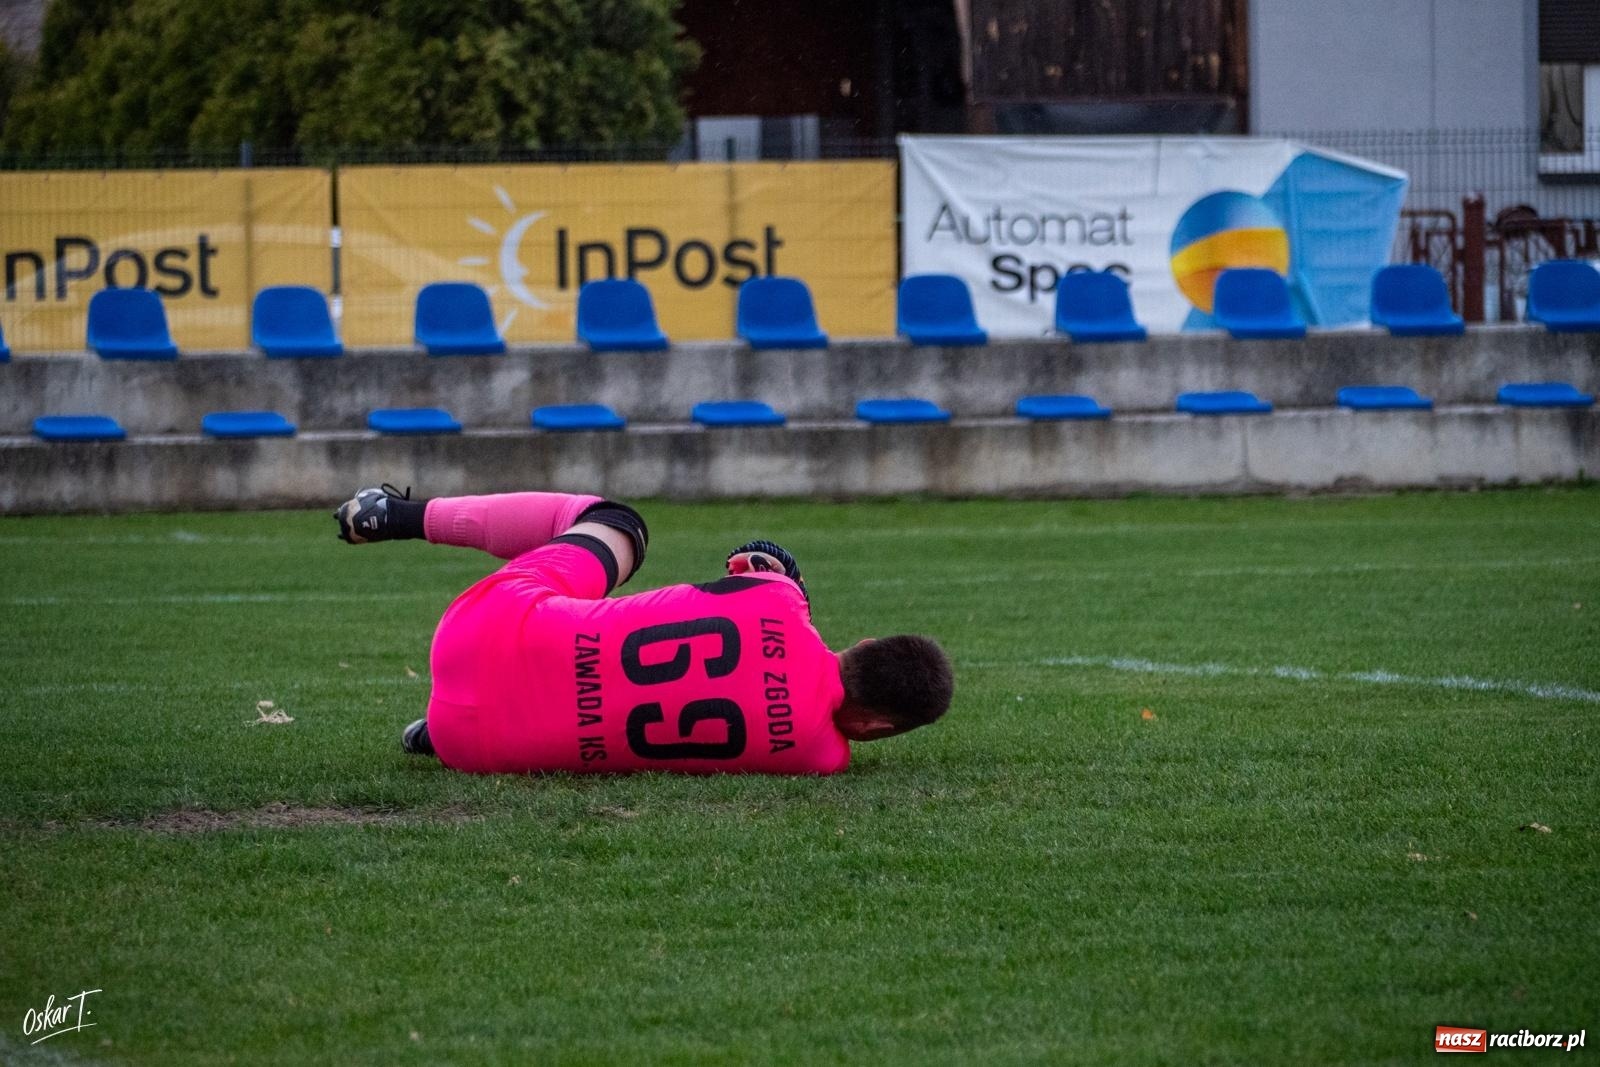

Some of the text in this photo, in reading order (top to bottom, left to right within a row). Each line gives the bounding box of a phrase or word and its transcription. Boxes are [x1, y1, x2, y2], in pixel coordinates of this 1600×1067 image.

[556, 225, 784, 291] InPost
[925, 203, 1135, 247] Automat
[4, 233, 219, 302] nPost
[990, 254, 1132, 302] Sp
[574, 632, 603, 727] ZAWADA
[620, 616, 747, 760] 69
[759, 617, 796, 754] LKS ZGODA
